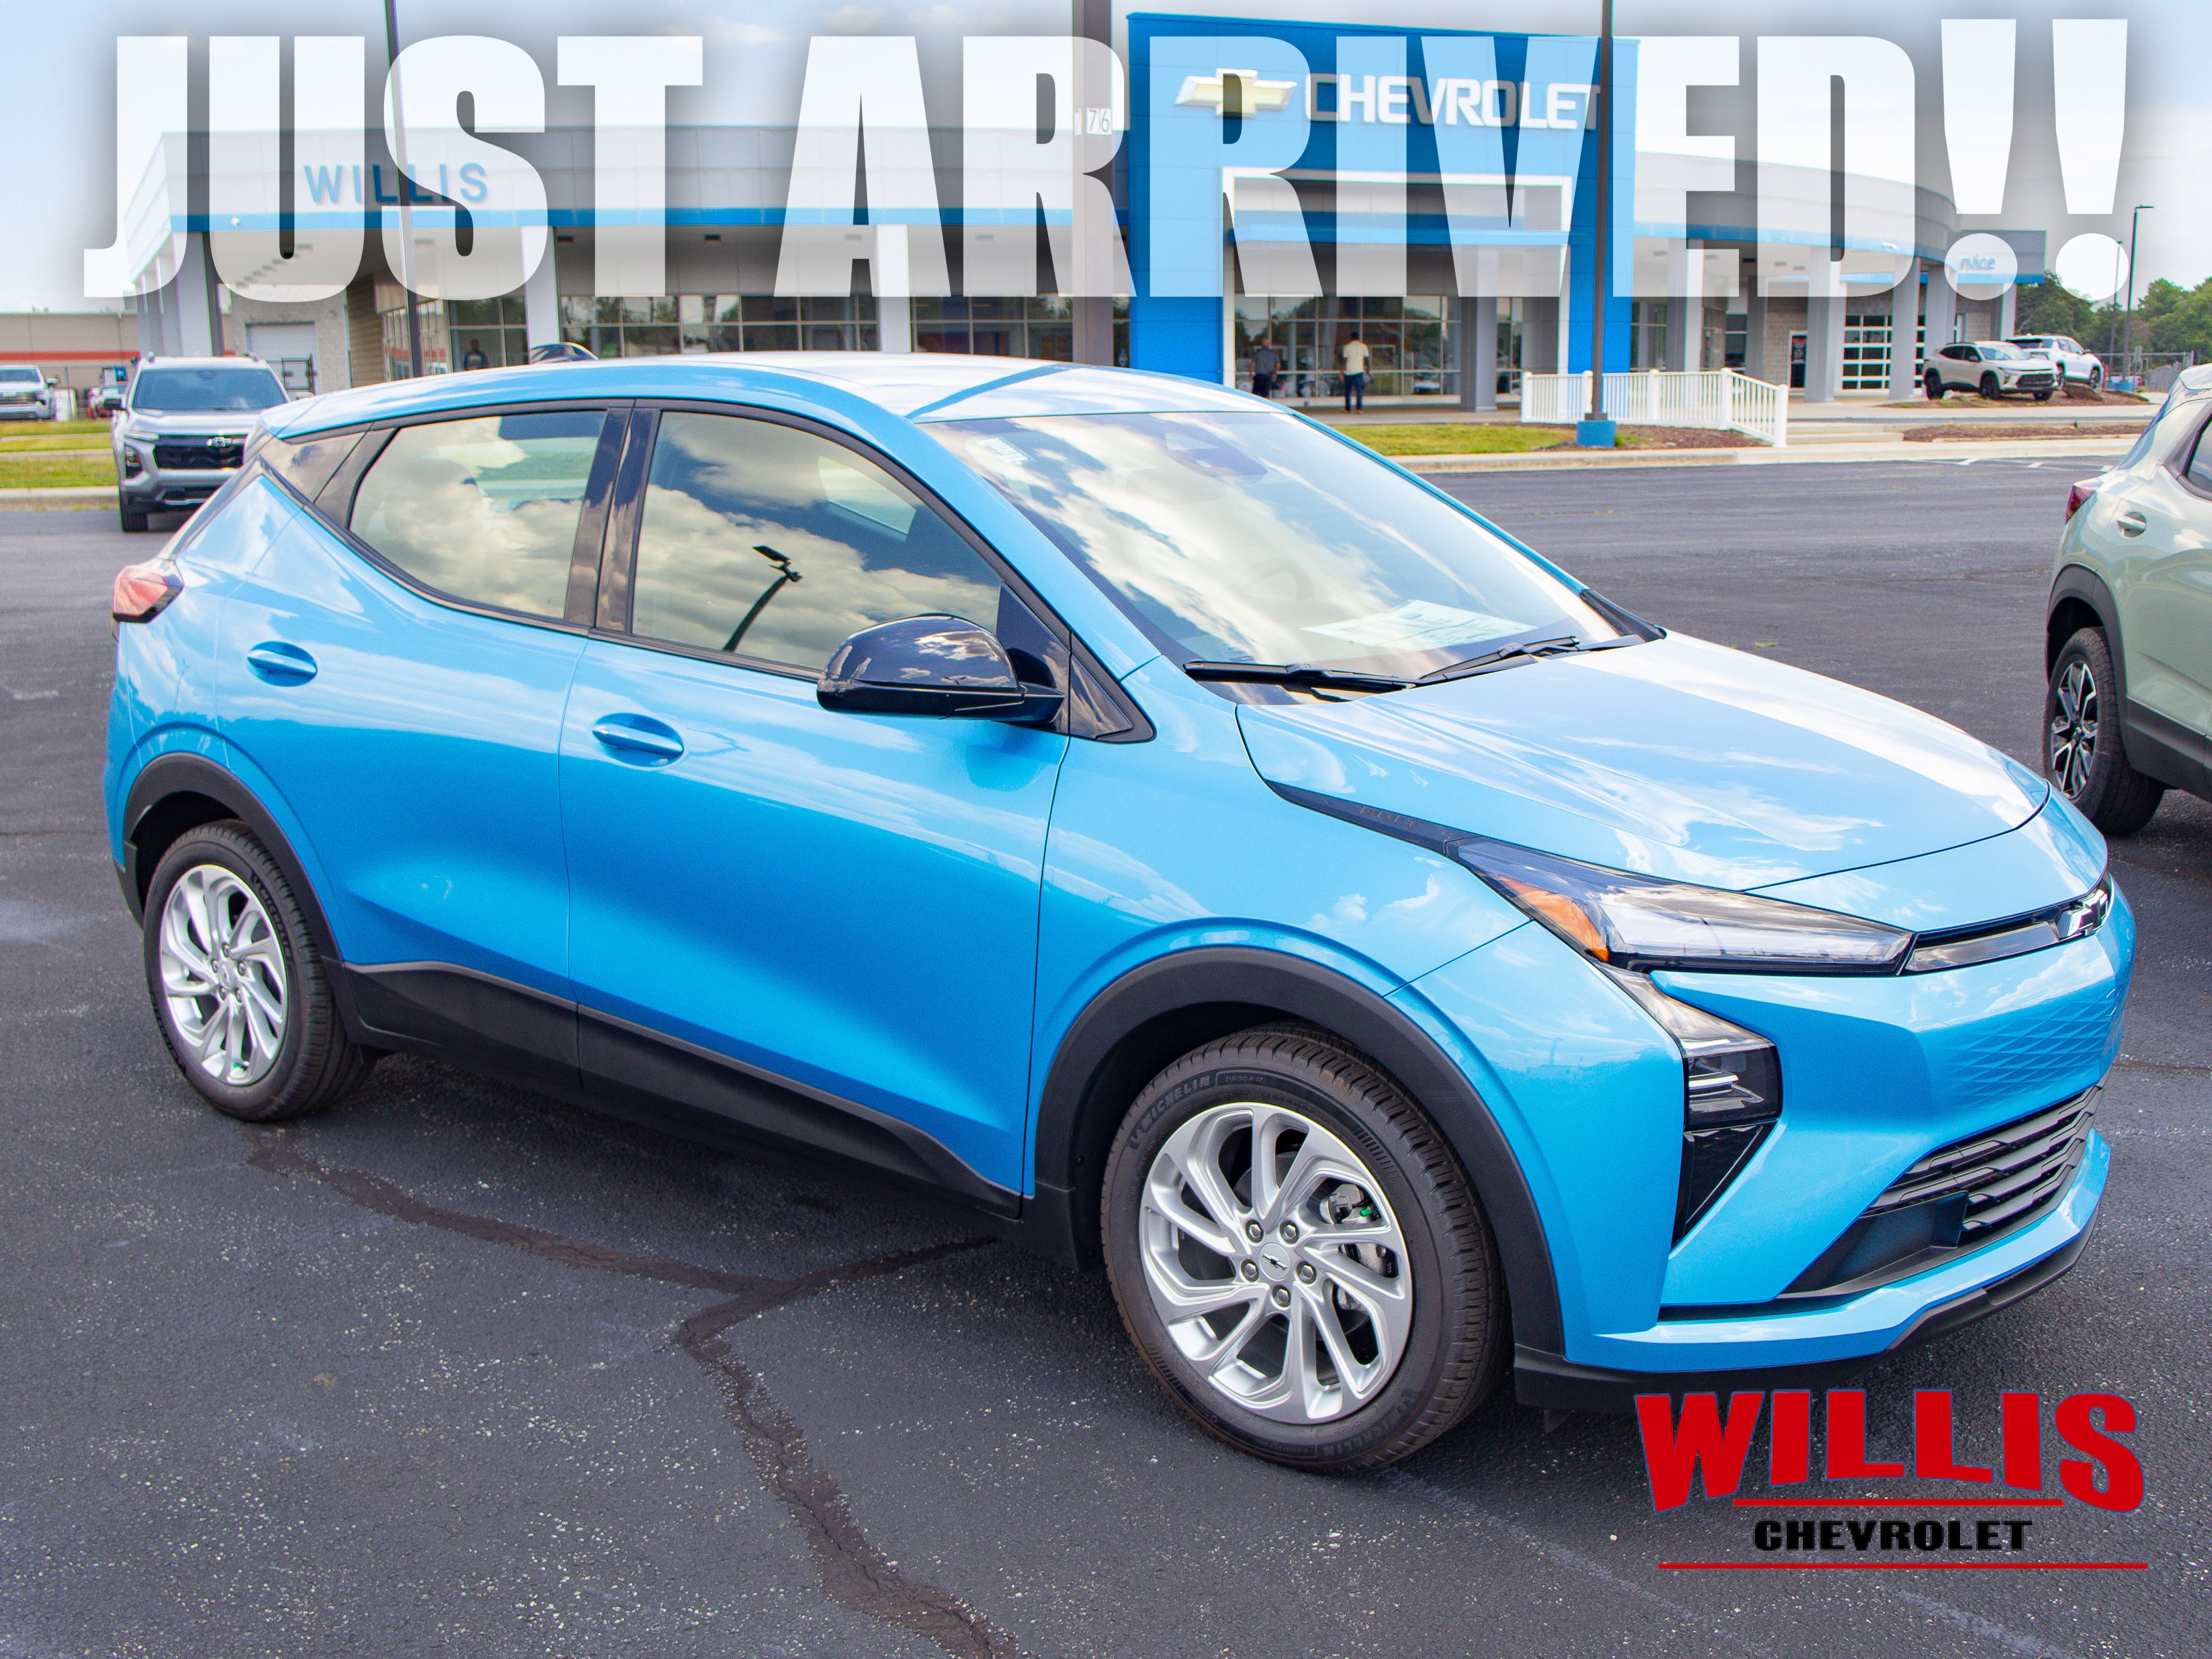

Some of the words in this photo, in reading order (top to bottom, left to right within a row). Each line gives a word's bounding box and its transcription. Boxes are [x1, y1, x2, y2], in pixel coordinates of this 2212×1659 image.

[1305, 72, 1601, 131] CHEVROLET
[304, 162, 488, 204] WILLIS
[1961, 253, 1997, 270] rvice
[1360, 806, 1424, 827] BOLT
[1141, 1075, 1210, 1130] MICHELIN
